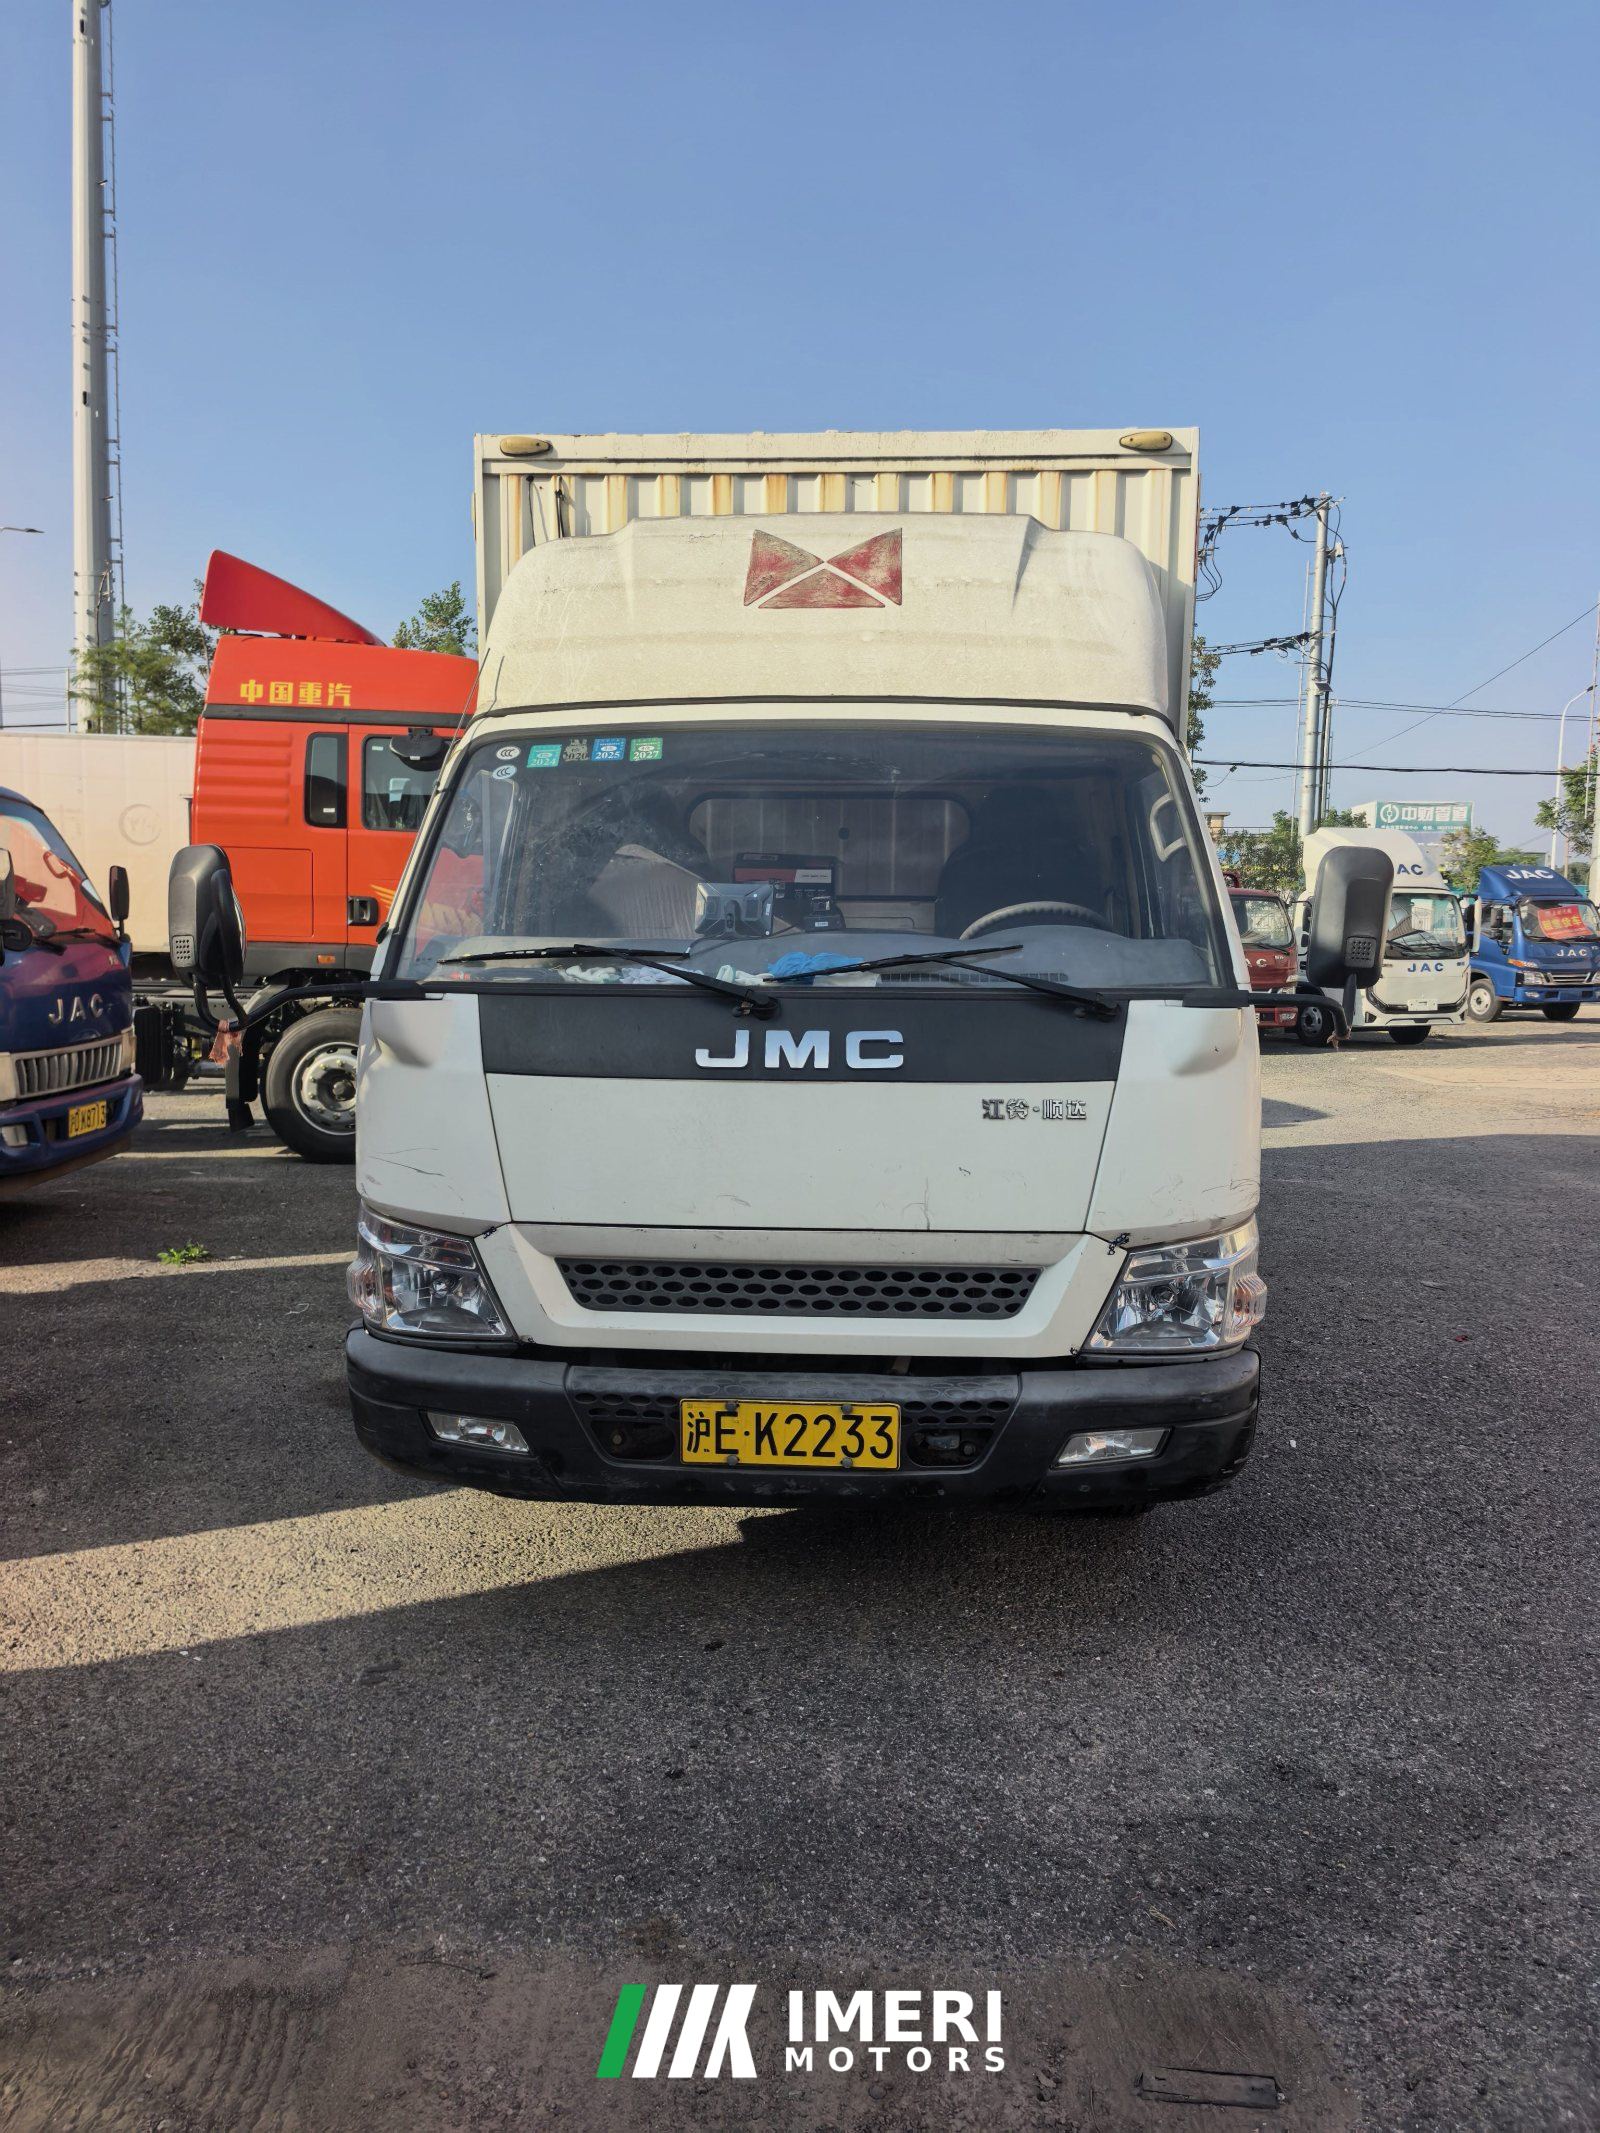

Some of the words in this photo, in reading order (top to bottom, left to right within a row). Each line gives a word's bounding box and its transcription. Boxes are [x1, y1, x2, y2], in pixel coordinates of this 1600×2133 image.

[240, 679, 352, 706] 中国重汽
[632, 751, 659, 760] 2027
[531, 758, 556, 766] 2024
[1396, 864, 1423, 875] AC
[1506, 869, 1553, 879] JAC
[1556, 949, 1587, 957] JAC
[1407, 962, 1444, 972] JAC
[48, 993, 103, 1024] JAC
[695, 1030, 904, 1069] JMC
[687, 1411, 893, 1459] 沪E·K2233
